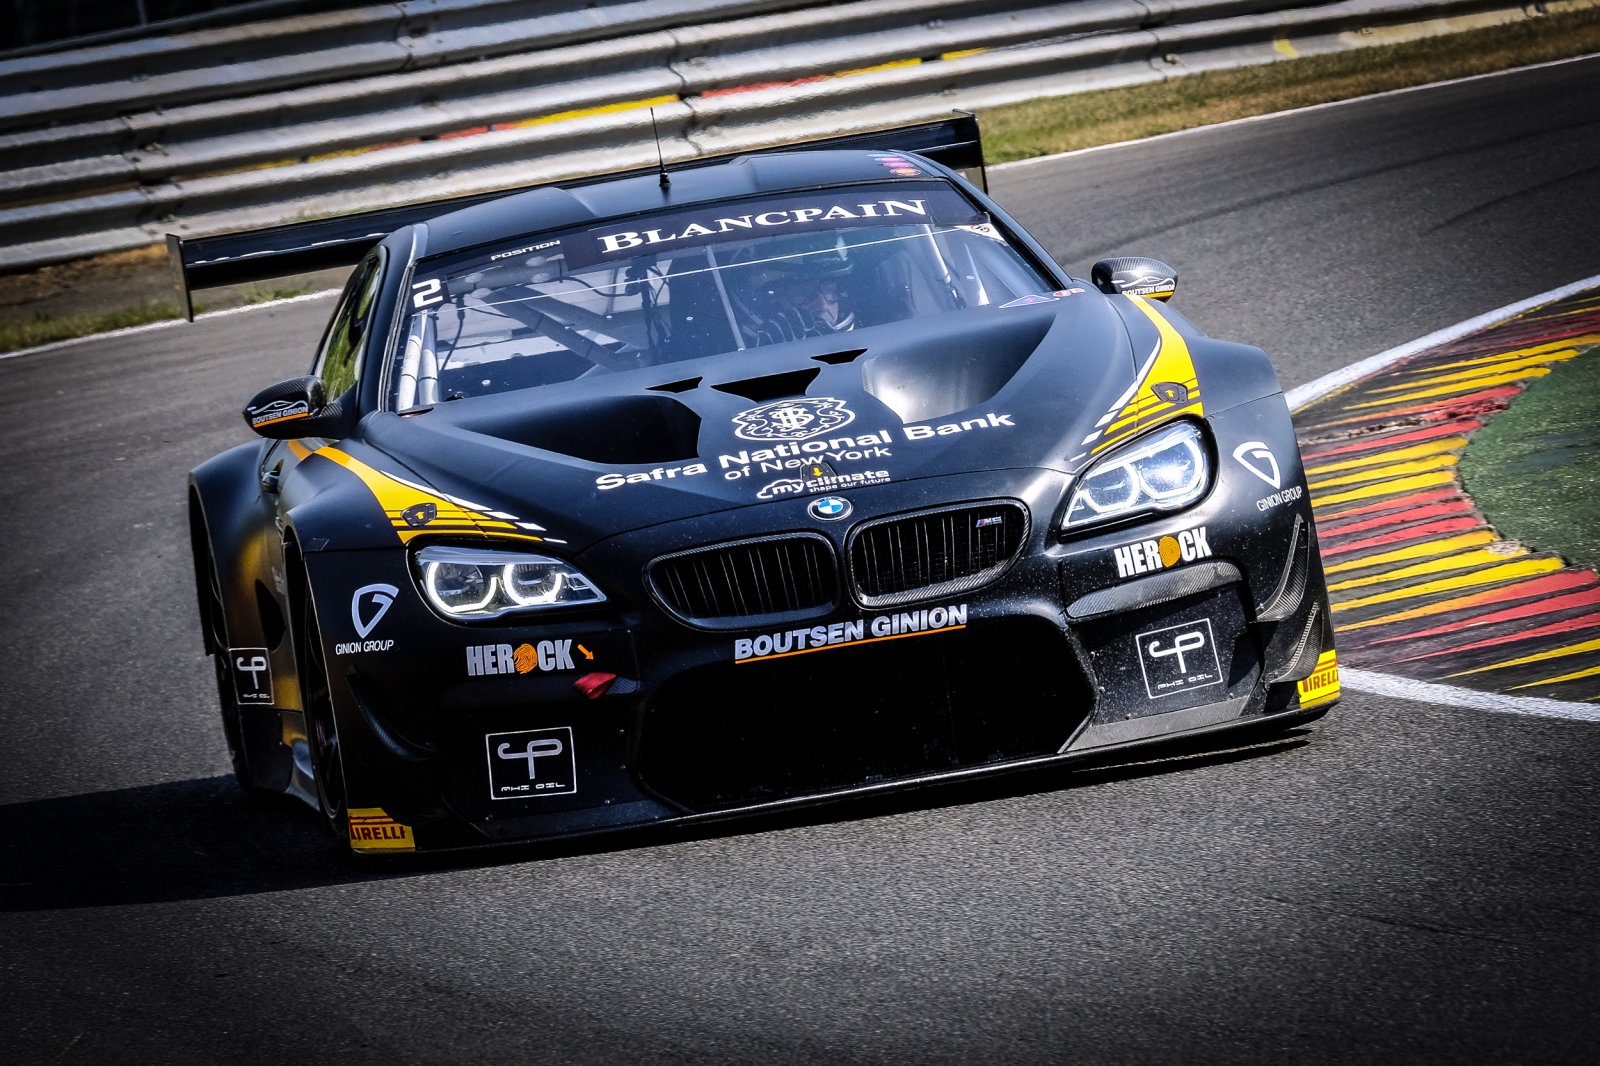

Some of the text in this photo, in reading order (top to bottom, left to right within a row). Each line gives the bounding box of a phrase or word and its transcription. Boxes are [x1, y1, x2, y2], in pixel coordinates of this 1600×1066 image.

[597, 199, 928, 253] BLANCPAIN
[490, 239, 561, 261] POSITION
[411, 278, 443, 308] 2
[252, 411, 282, 425] BOUTSEN
[595, 413, 1016, 490] Safra National Bank
[724, 446, 893, 480] of New York
[771, 470, 890, 494] myclimate
[809, 484, 838, 494] shape
[860, 477, 891, 486] future
[1256, 486, 1303, 512] GINION GROUP
[734, 603, 968, 660] BOUTSEN GINION
[335, 639, 395, 656] GINION GROUP
